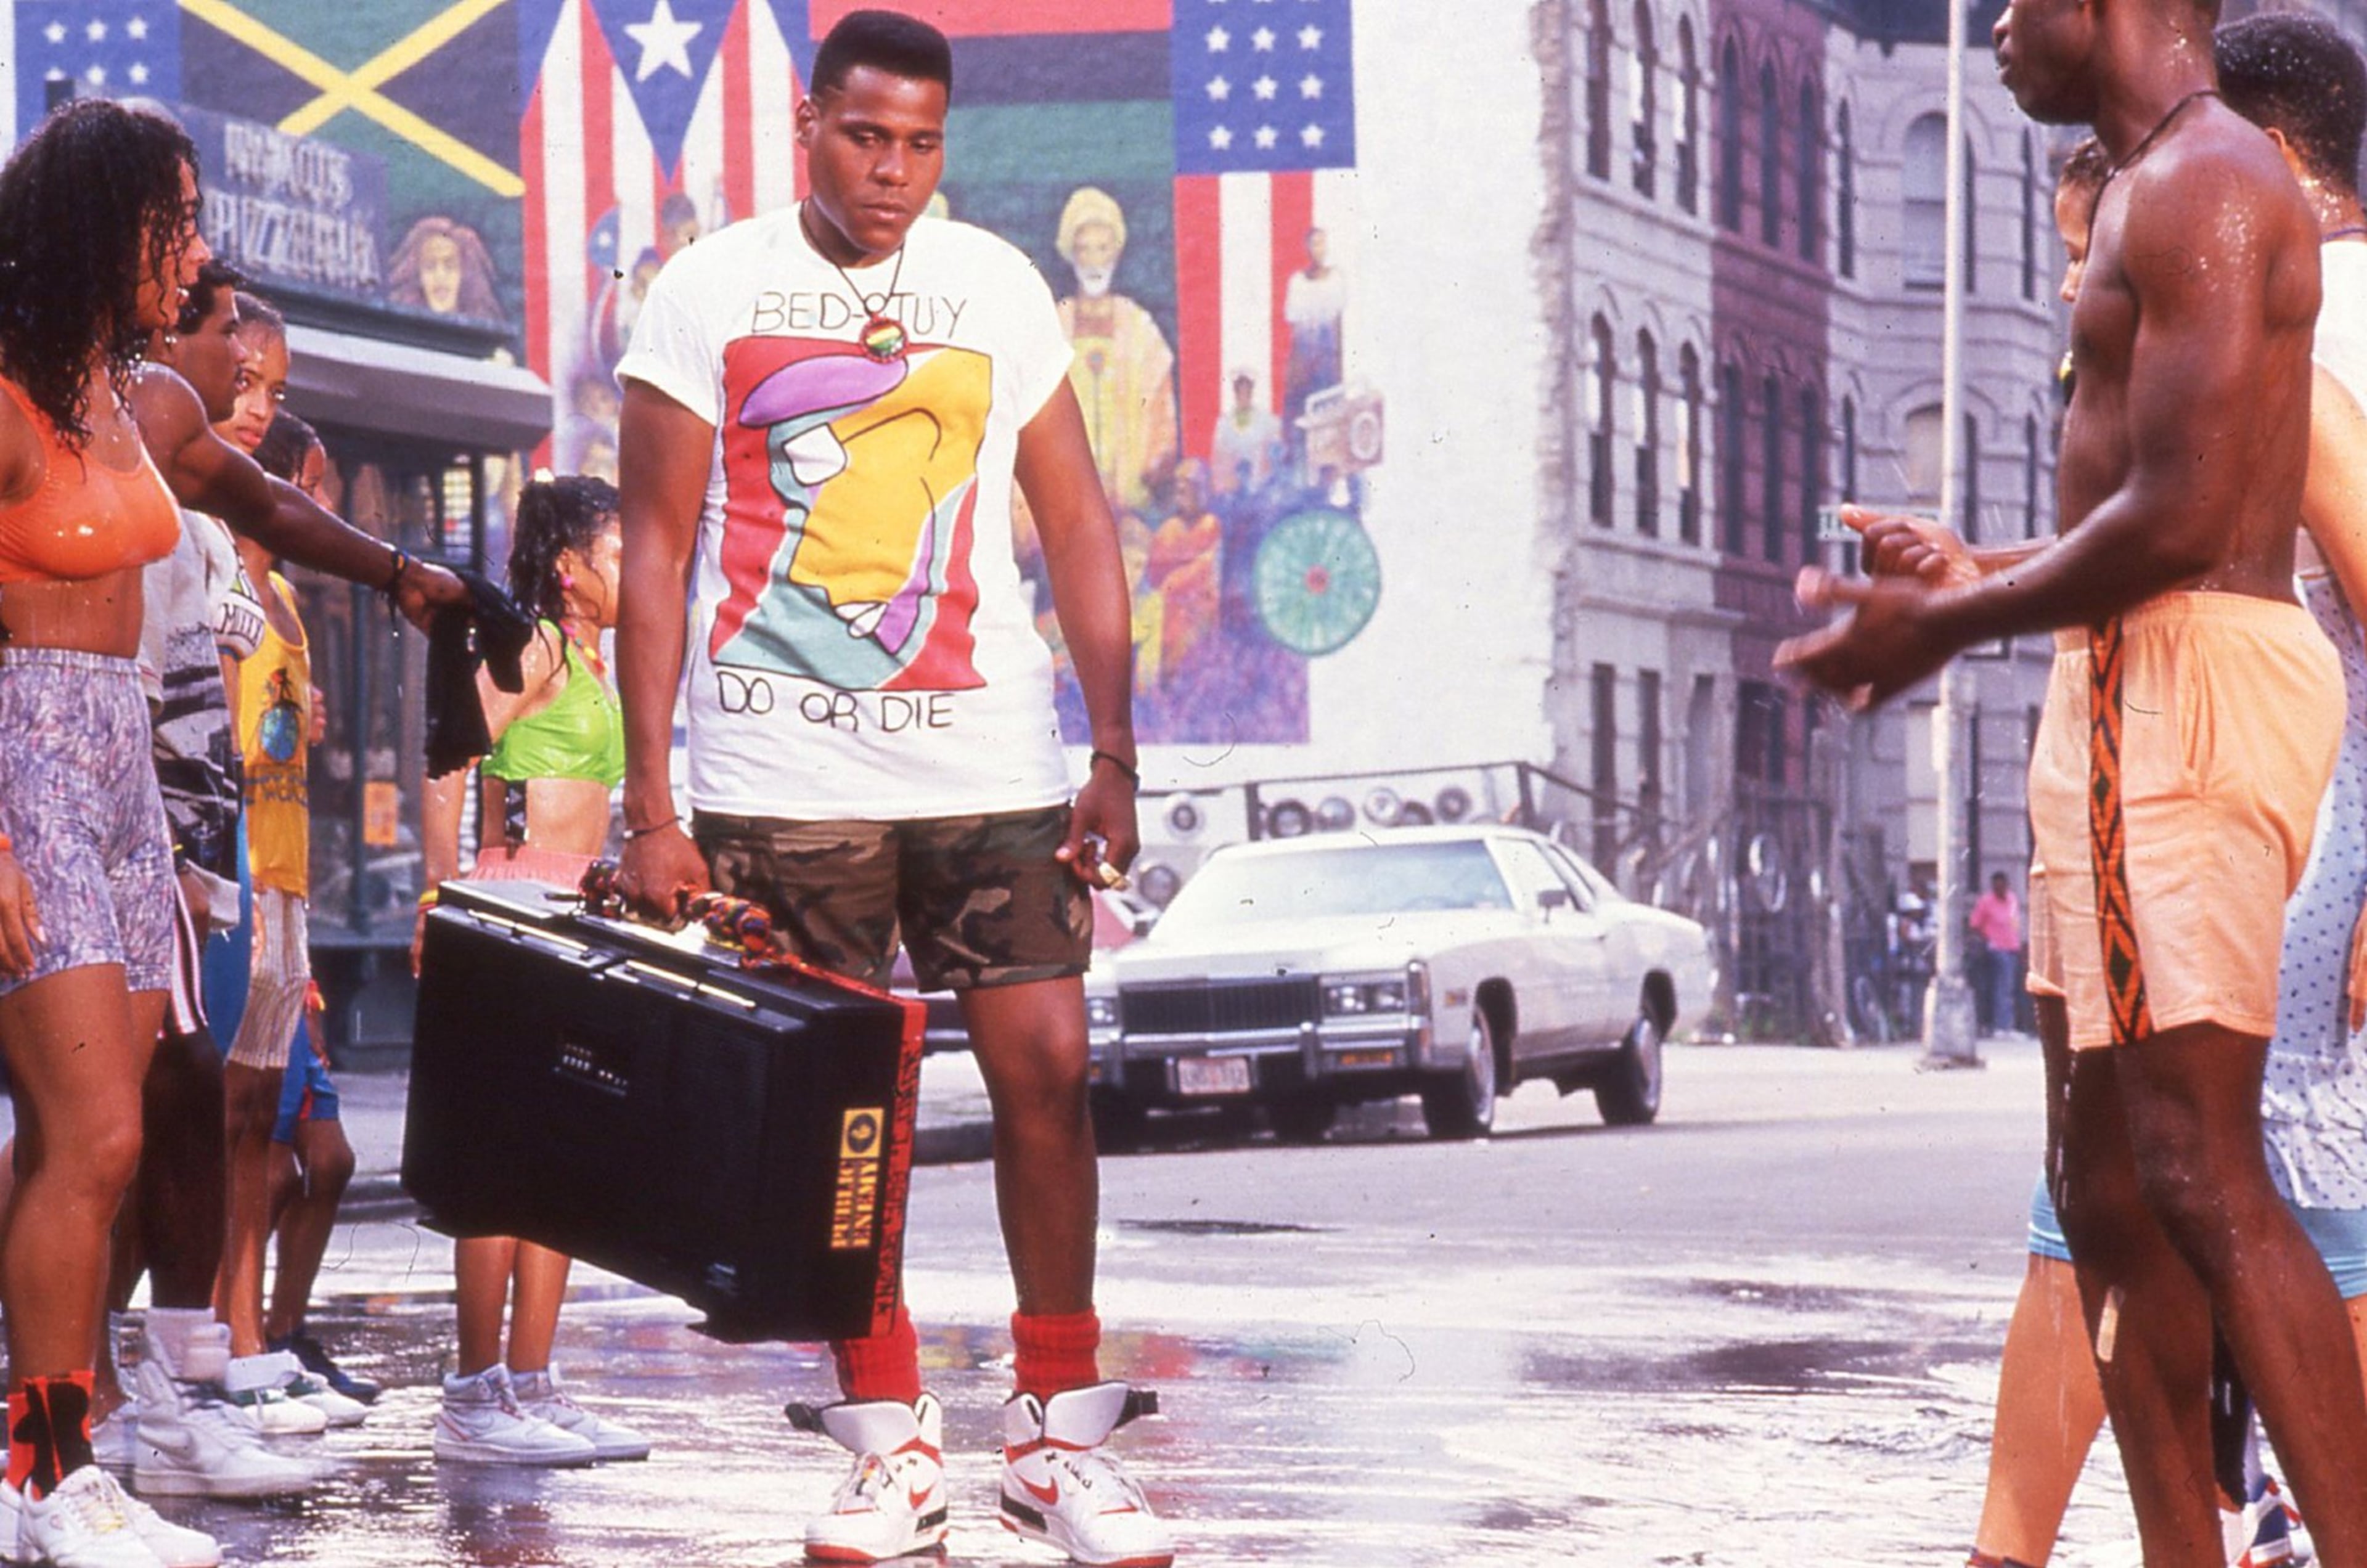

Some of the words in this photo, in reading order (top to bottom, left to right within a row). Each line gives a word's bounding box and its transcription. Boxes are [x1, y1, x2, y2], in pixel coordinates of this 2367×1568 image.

[751, 292, 968, 339] BED-TUY
[717, 671, 774, 714] DO
[800, 692, 859, 732] OR
[880, 693, 955, 732] DIE
[831, 1160, 854, 1247] PUBLIC
[853, 1162, 878, 1247] ENEMY
